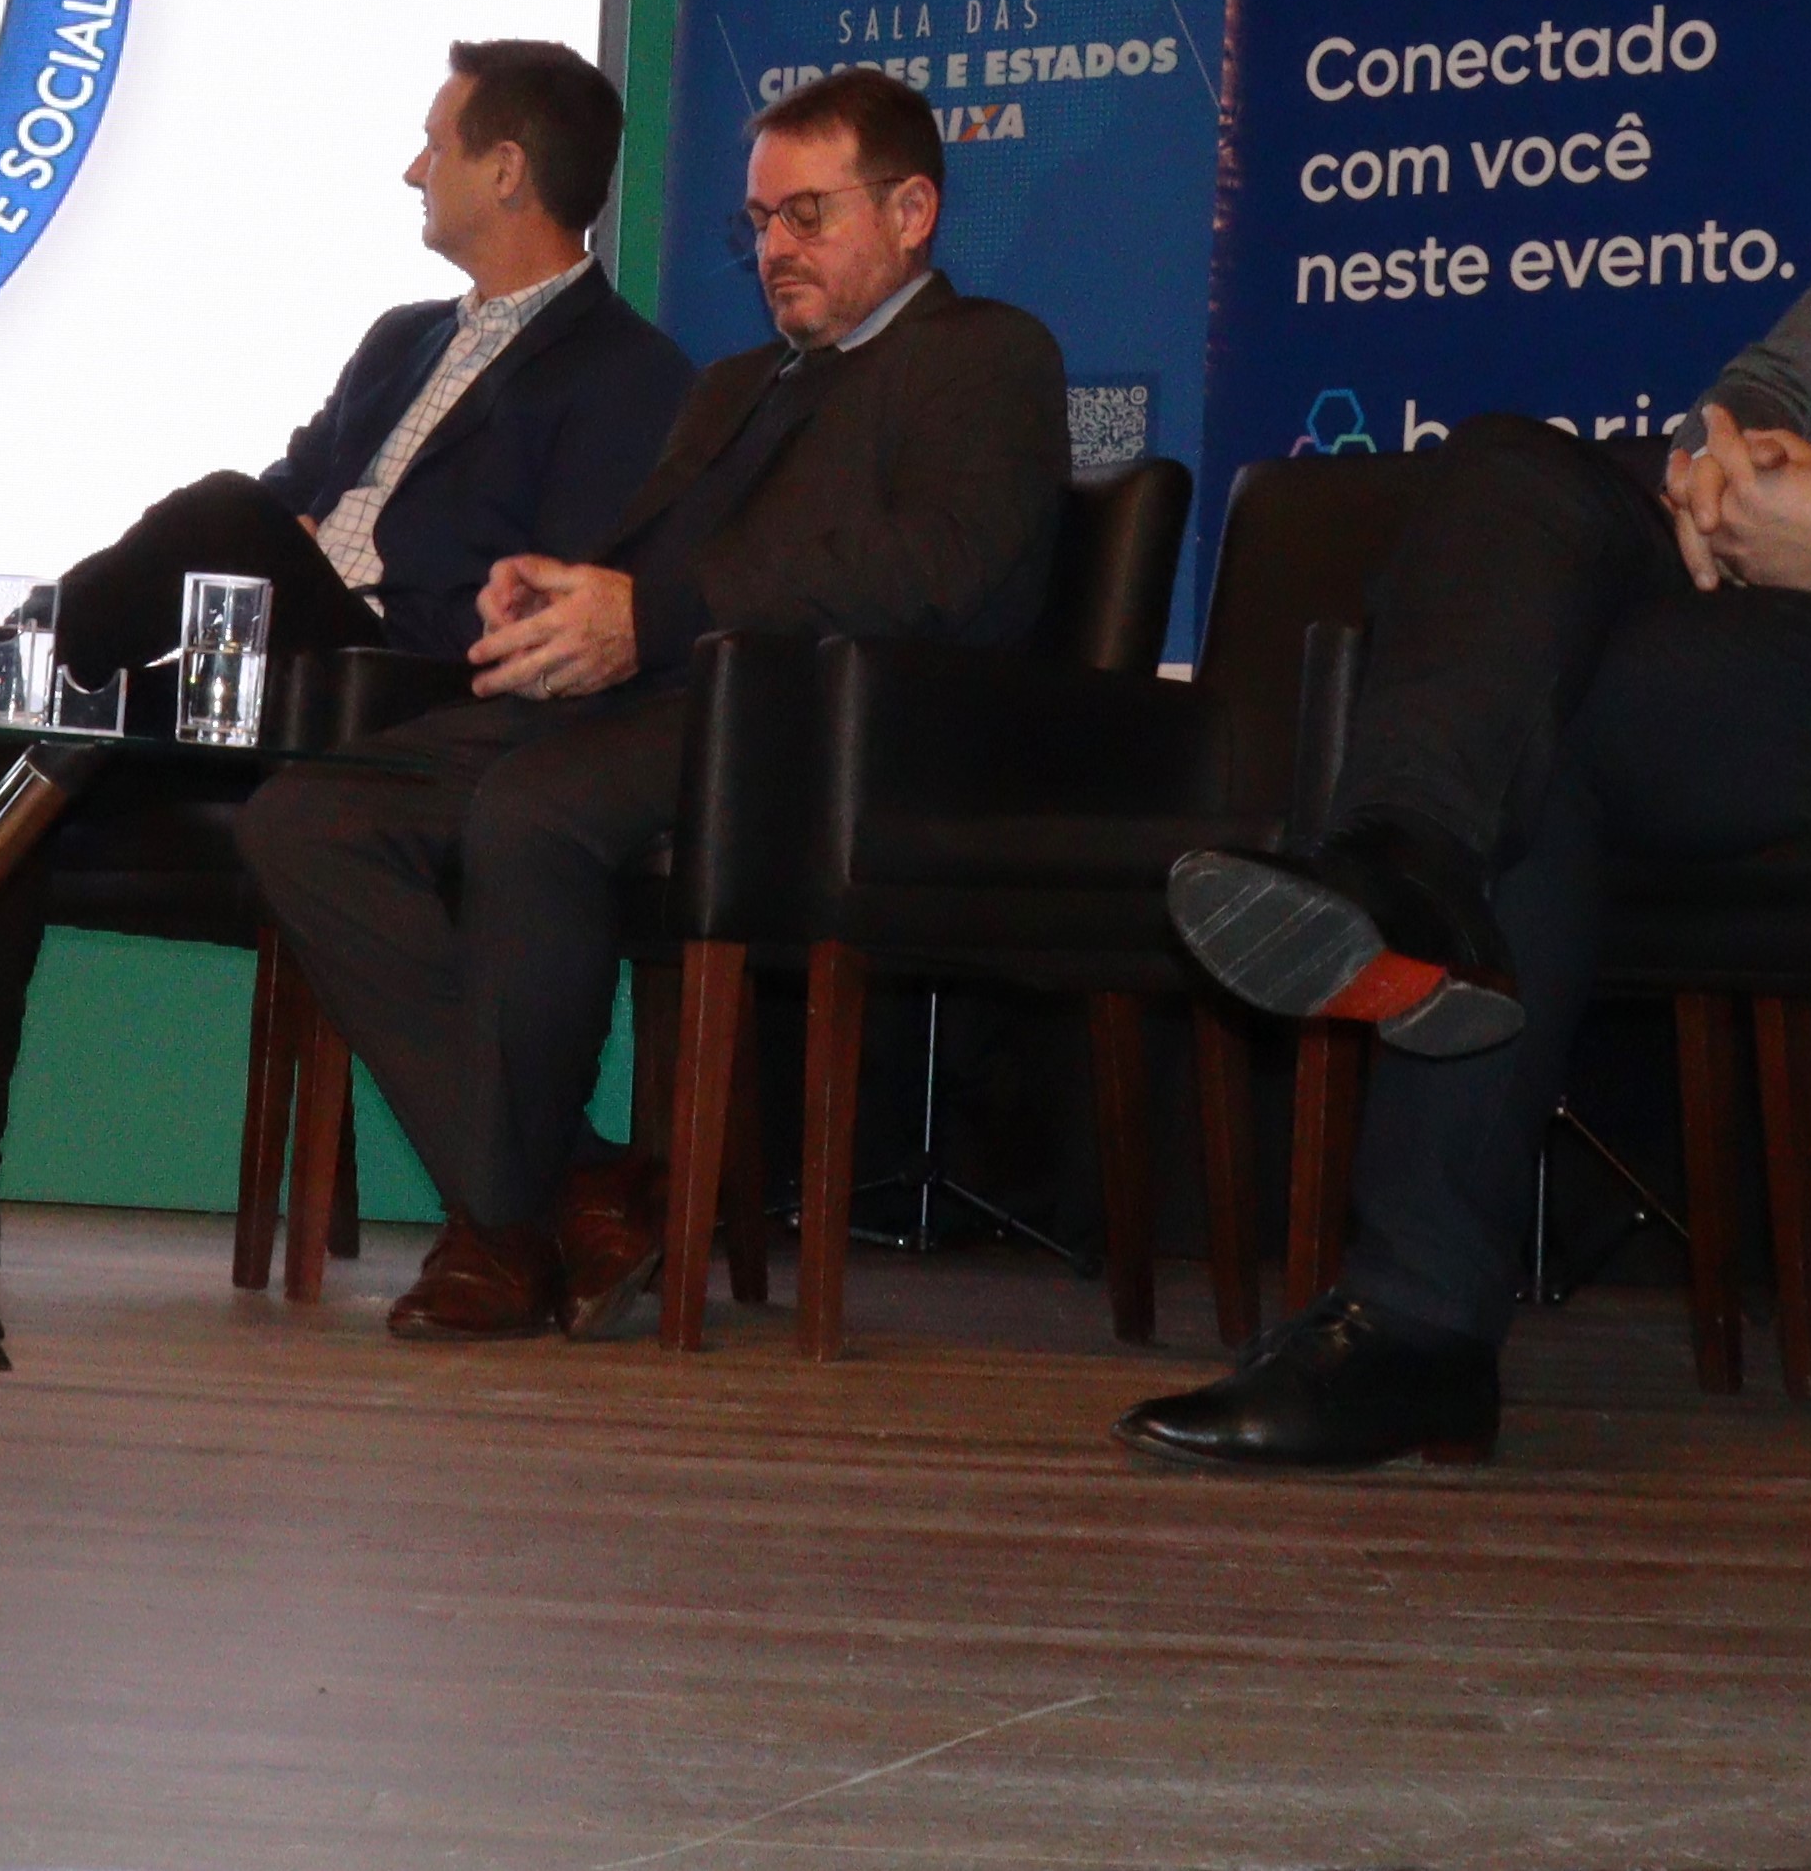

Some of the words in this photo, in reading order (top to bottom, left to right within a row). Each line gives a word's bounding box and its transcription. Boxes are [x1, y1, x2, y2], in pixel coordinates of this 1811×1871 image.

[838, 3, 931, 44] SALA
[1306, 4, 1717, 101] Conectado
[759, 56, 931, 102] CIES
[946, 53, 968, 88] E
[985, 37, 1178, 86] ESTADOS
[933, 103, 1025, 142] IXA
[1300, 143, 1449, 203] com
[1470, 112, 1651, 189] você
[1297, 237, 1489, 304] neste
[1509, 220, 1795, 292] evento.
